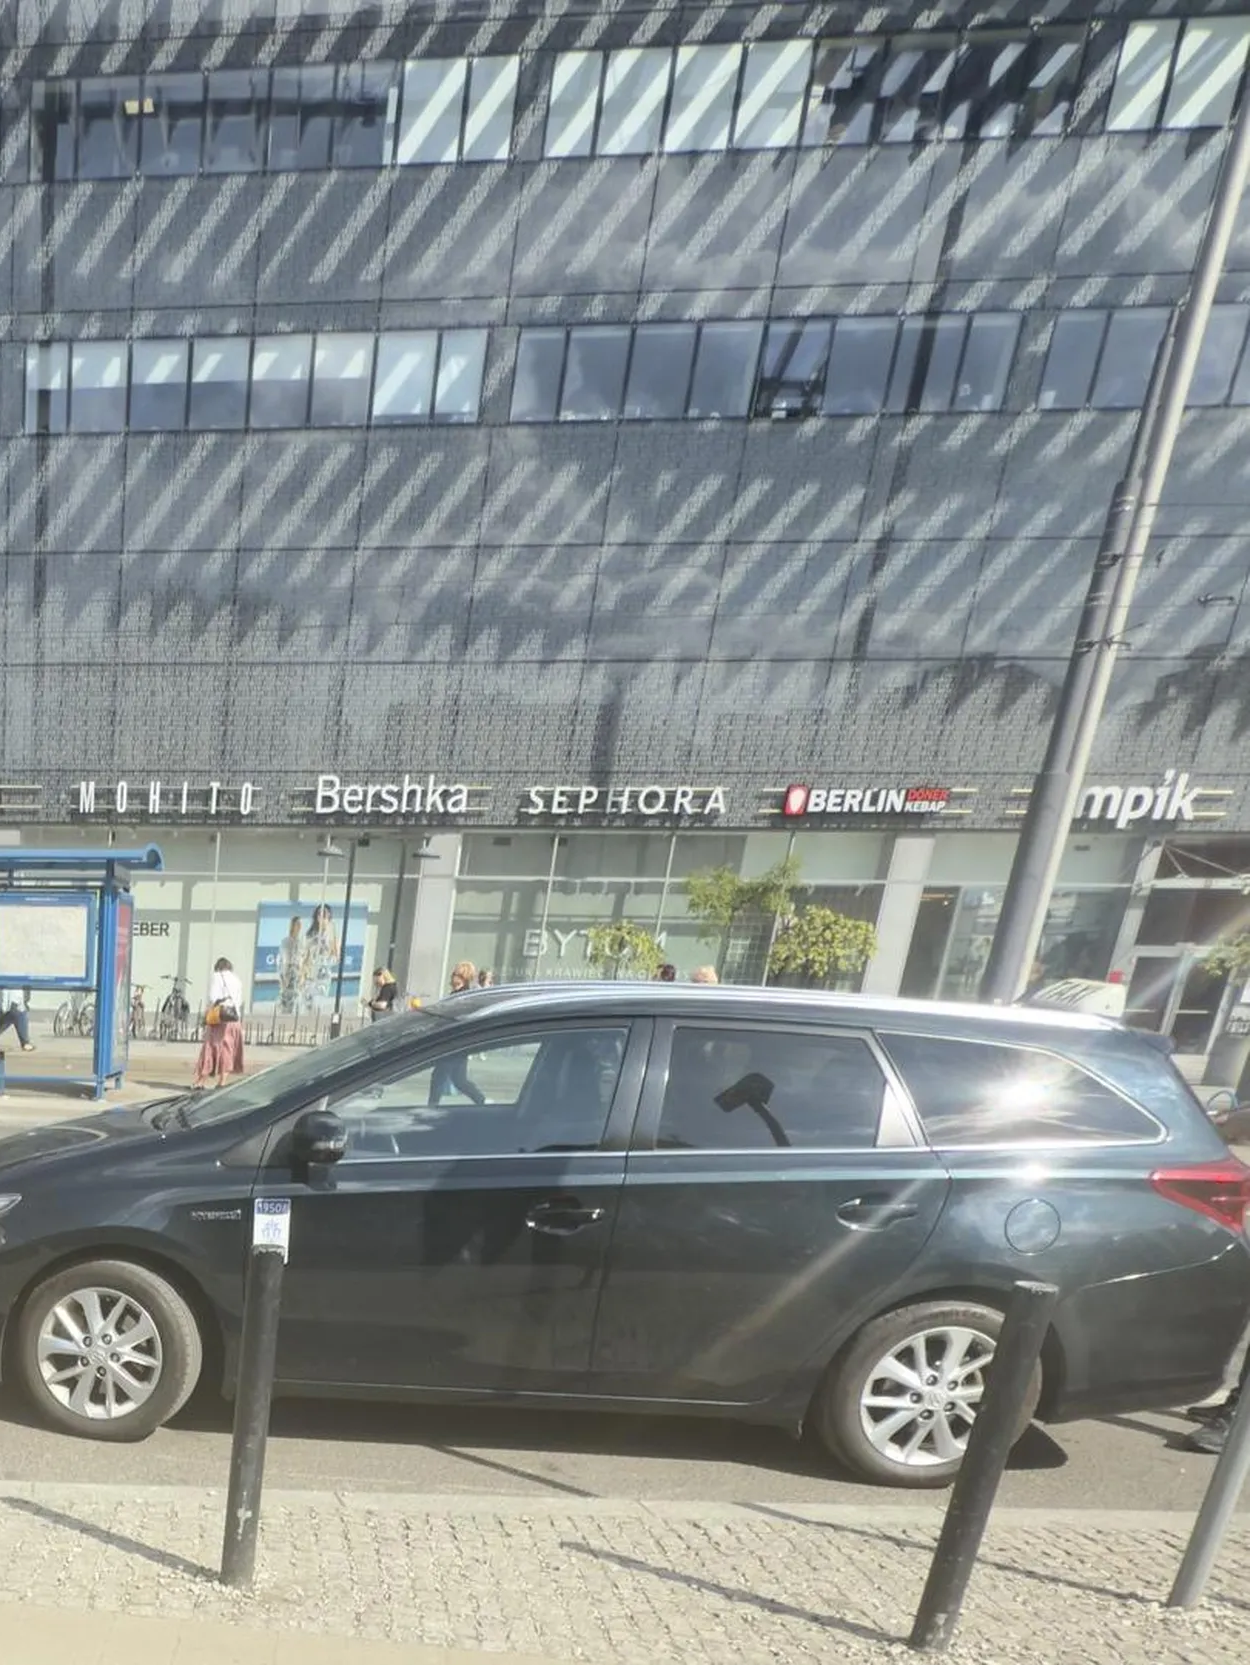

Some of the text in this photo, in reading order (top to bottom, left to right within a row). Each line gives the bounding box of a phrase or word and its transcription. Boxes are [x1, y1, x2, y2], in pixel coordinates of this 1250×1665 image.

[79, 781, 253, 815] MOHITO
[315, 774, 468, 814] Bershka
[528, 785, 727, 815] SEPHORA
[806, 788, 906, 813] BERLIN
[904, 801, 946, 812] KEBAP
[1074, 768, 1204, 829] mpik
[132, 921, 170, 936] EBER
[522, 928, 669, 958] BYTO
